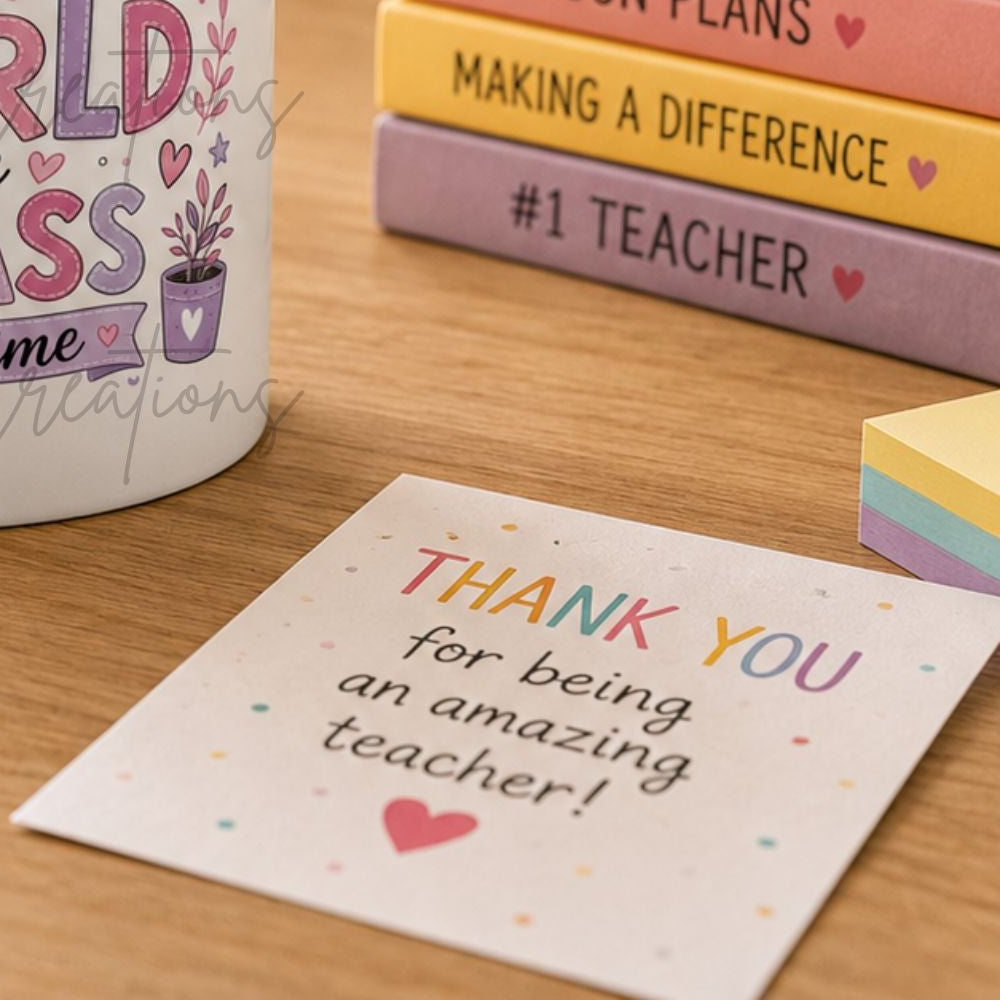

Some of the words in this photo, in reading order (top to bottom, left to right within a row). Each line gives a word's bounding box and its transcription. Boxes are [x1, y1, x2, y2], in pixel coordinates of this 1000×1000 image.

[453, 51, 599, 123] MAKING
[617, 87, 640, 133] A
[659, 93, 888, 187] DIFFERENCE
[509, 182, 565, 239] #1
[590, 196, 808, 299] TEACHER
[400, 547, 680, 650] THANK
[702, 616, 863, 693] YOU
[402, 625, 504, 670] for
[519, 650, 694, 736] being
[322, 713, 611, 818] teacher!
[337, 669, 412, 708] an
[428, 694, 693, 796] amazing
